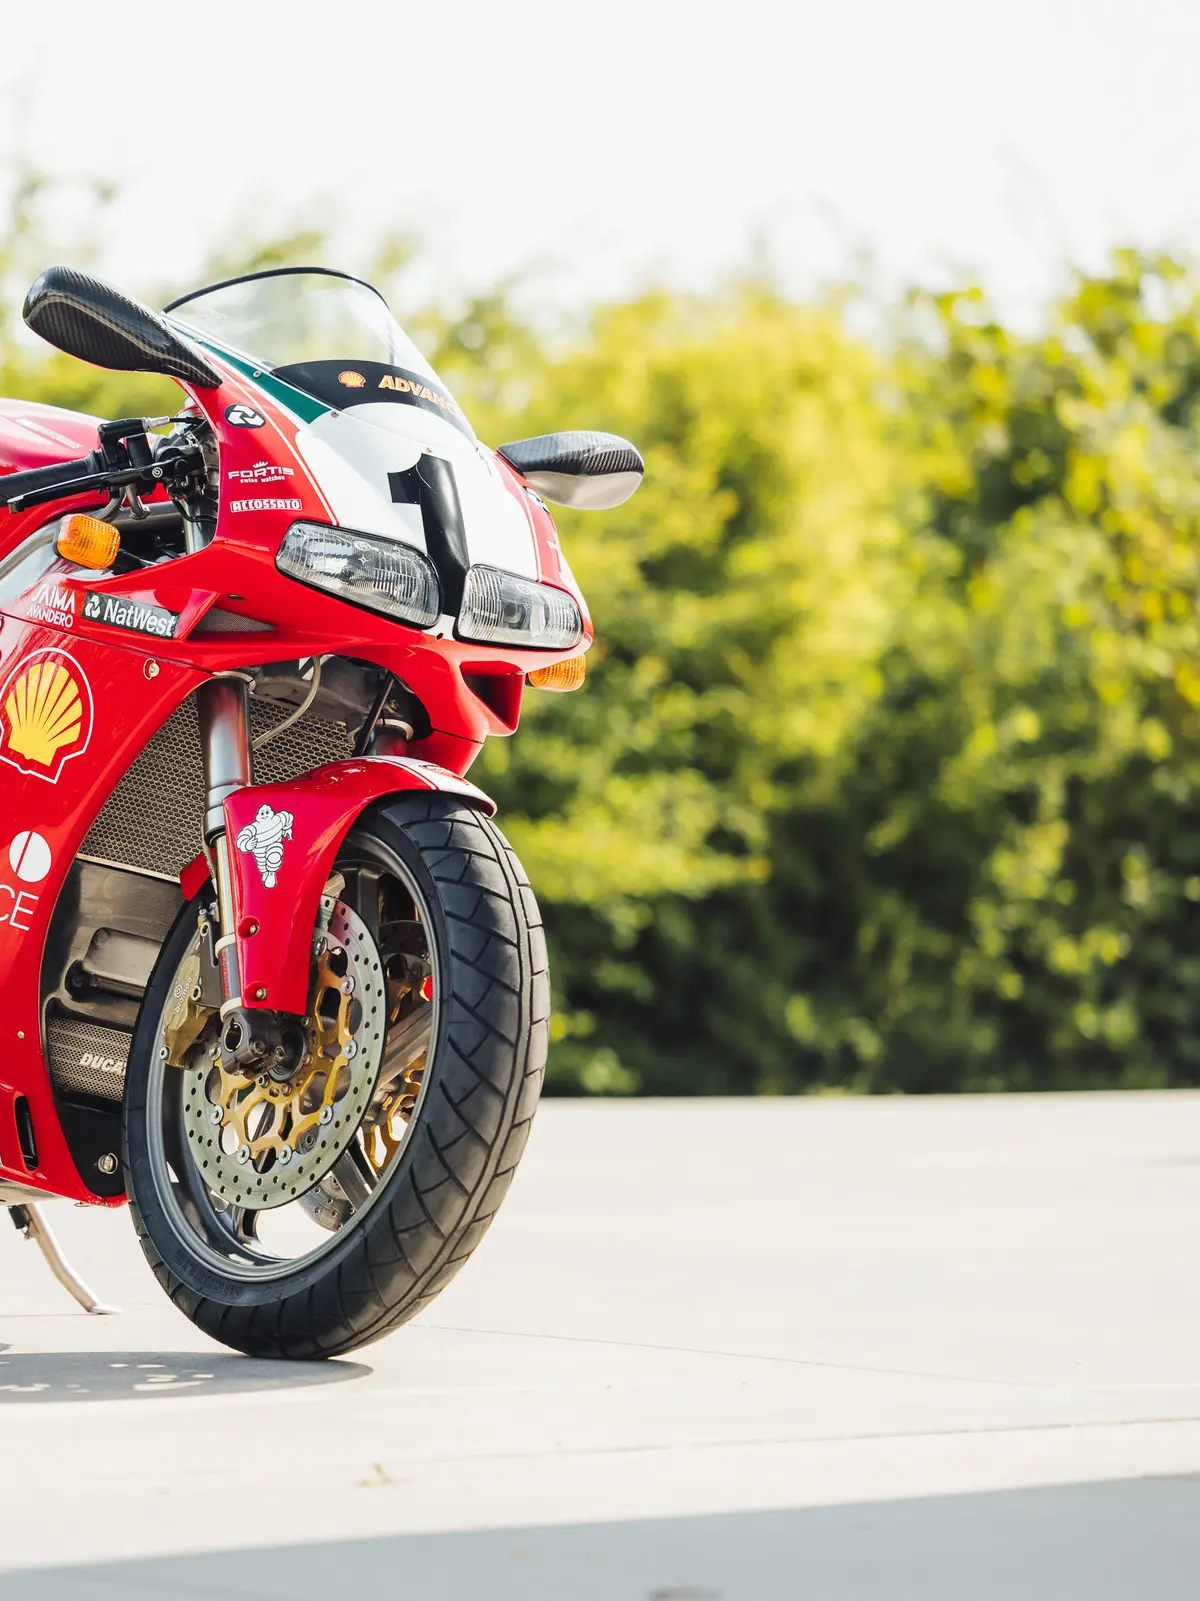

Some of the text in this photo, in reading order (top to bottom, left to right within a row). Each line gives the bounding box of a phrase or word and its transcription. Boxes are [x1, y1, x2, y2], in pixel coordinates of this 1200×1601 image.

[228, 466, 294, 479] FORTIS
[261, 475, 285, 483] watches
[232, 499, 300, 512] ACCOSSATO
[387, 453, 471, 618] 1
[103, 598, 176, 637] NatWest
